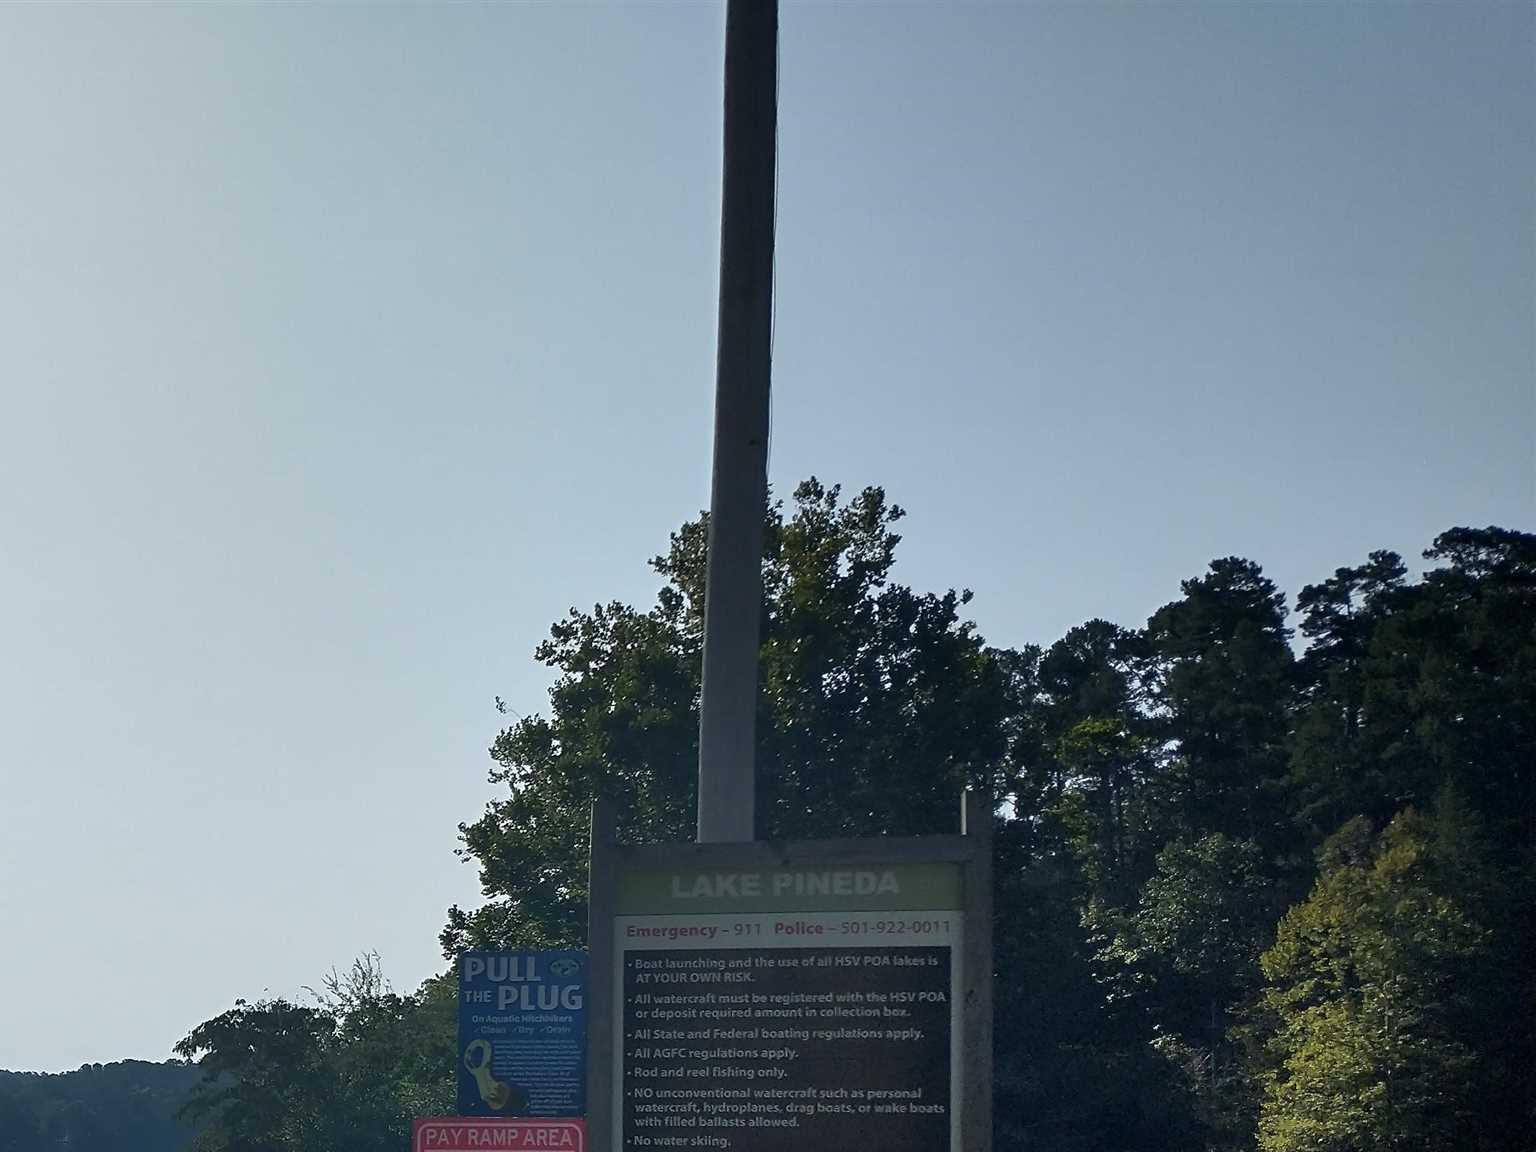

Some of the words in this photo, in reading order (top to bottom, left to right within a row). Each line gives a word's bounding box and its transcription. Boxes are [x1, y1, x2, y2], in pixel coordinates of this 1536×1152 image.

[672, 874, 761, 898] LAKE
[774, 871, 901, 897] PINEDA
[626, 925, 719, 940] Emergency
[734, 923, 761, 937] 911
[775, 921, 824, 936] Police
[841, 920, 950, 934] 501-922-0011
[464, 956, 542, 982] PULL
[635, 959, 664, 968] Boat
[666, 958, 724, 971] launching
[728, 958, 752, 968] and
[755, 958, 774, 967] the
[817, 957, 832, 967] all
[835, 957, 860, 967] HSV
[864, 957, 890, 967] POA
[894, 956, 924, 966] lakes
[635, 972, 650, 982] AT
[654, 972, 686, 982] YOUR
[690, 971, 720, 982] OWN
[724, 970, 755, 981] RISK.
[464, 991, 492, 1003] THE
[497, 985, 583, 1010] PLUG
[635, 994, 651, 1003] All
[654, 994, 715, 1003] watercraft
[719, 993, 749, 1003] must
[752, 993, 767, 1002] be
[769, 993, 832, 1005] registered
[835, 993, 863, 1002] with
[866, 992, 887, 1002] the
[890, 992, 915, 1002] HSV
[918, 992, 945, 1002] POA
[485, 1014, 520, 1025] Aquatic
[652, 1008, 695, 1021] deposit
[699, 1008, 751, 1021] required
[754, 1008, 802, 1017] amount
[820, 1007, 880, 1017] collection
[883, 1007, 911, 1017] box.
[635, 1030, 650, 1039] All
[654, 1030, 685, 1039] State
[688, 1030, 710, 1039] and
[714, 1029, 758, 1039] Federal
[762, 1029, 809, 1042] boating
[813, 1029, 882, 1041] regulations
[886, 1028, 924, 1041] apply.
[635, 1048, 650, 1058] All
[654, 1048, 686, 1058] AGFC
[689, 1048, 758, 1061] regulations
[760, 1048, 799, 1061] apply.
[635, 1067, 657, 1077] Rod
[661, 1067, 683, 1077] and
[687, 1067, 709, 1077] reel
[713, 1067, 754, 1080] fishing
[758, 1067, 787, 1080] only.
[634, 1088, 653, 1098] NO
[656, 1088, 750, 1098] unconventional
[754, 1088, 816, 1098] watercraft
[819, 1088, 848, 1098] such
[867, 1088, 921, 1101] personal
[635, 1102, 700, 1114] watercraft,
[704, 1102, 783, 1115] hydroplanes,
[785, 1102, 814, 1115] drag
[817, 1102, 855, 1114] boats,
[874, 1102, 907, 1112] wake
[910, 1102, 944, 1112] boats
[635, 1117, 662, 1127] with
[665, 1117, 694, 1127] filled
[699, 1117, 745, 1127] ballasts
[749, 1117, 799, 1127] allowed.
[426, 1127, 462, 1145] PAY
[468, 1128, 518, 1146] RAMP
[523, 1129, 573, 1147] AREA
[634, 1136, 650, 1145] No
[654, 1136, 687, 1145] water
[691, 1136, 731, 1148] skiing.
